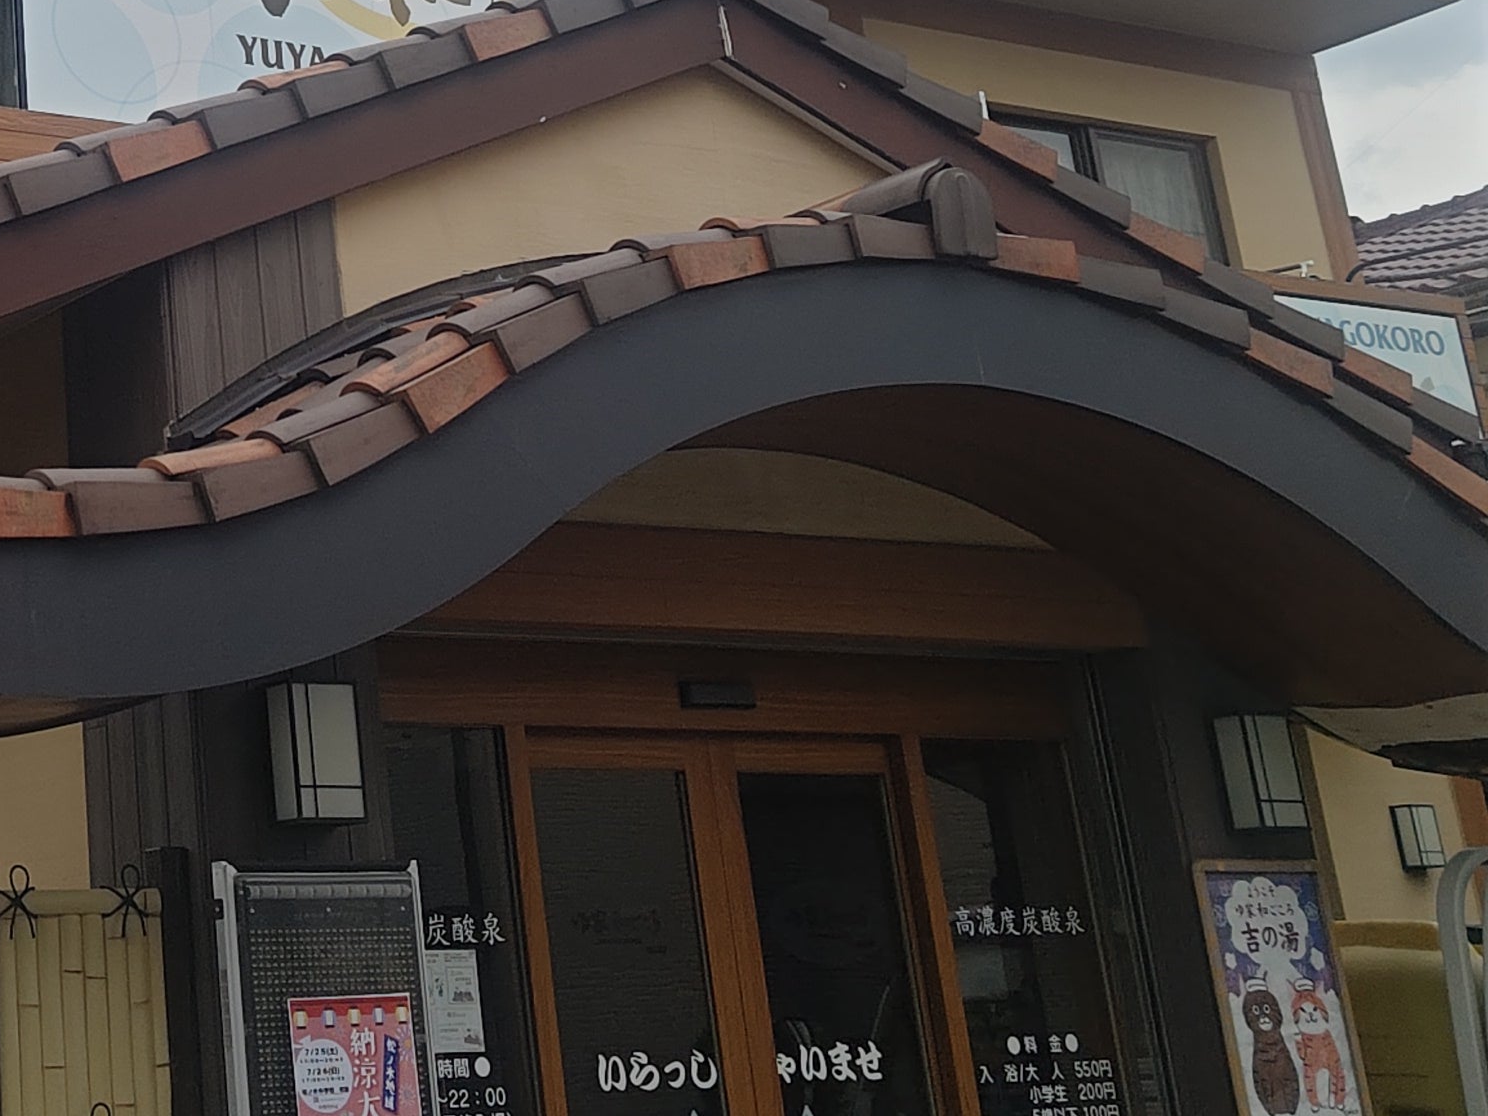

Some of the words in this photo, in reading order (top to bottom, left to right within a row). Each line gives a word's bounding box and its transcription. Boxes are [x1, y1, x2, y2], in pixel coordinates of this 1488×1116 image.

[235, 33, 326, 70] YUYA
[1317, 317, 1445, 356] GOKORO
[426, 912, 506, 947] 炭酸泉
[954, 905, 1086, 937] 高濃度炭酸泉
[1241, 922, 1300, 953] 吉の湯
[1074, 1059, 1113, 1079] 550円
[1029, 1084, 1069, 1104] 小学生
[1078, 1082, 1117, 1101] 200円
